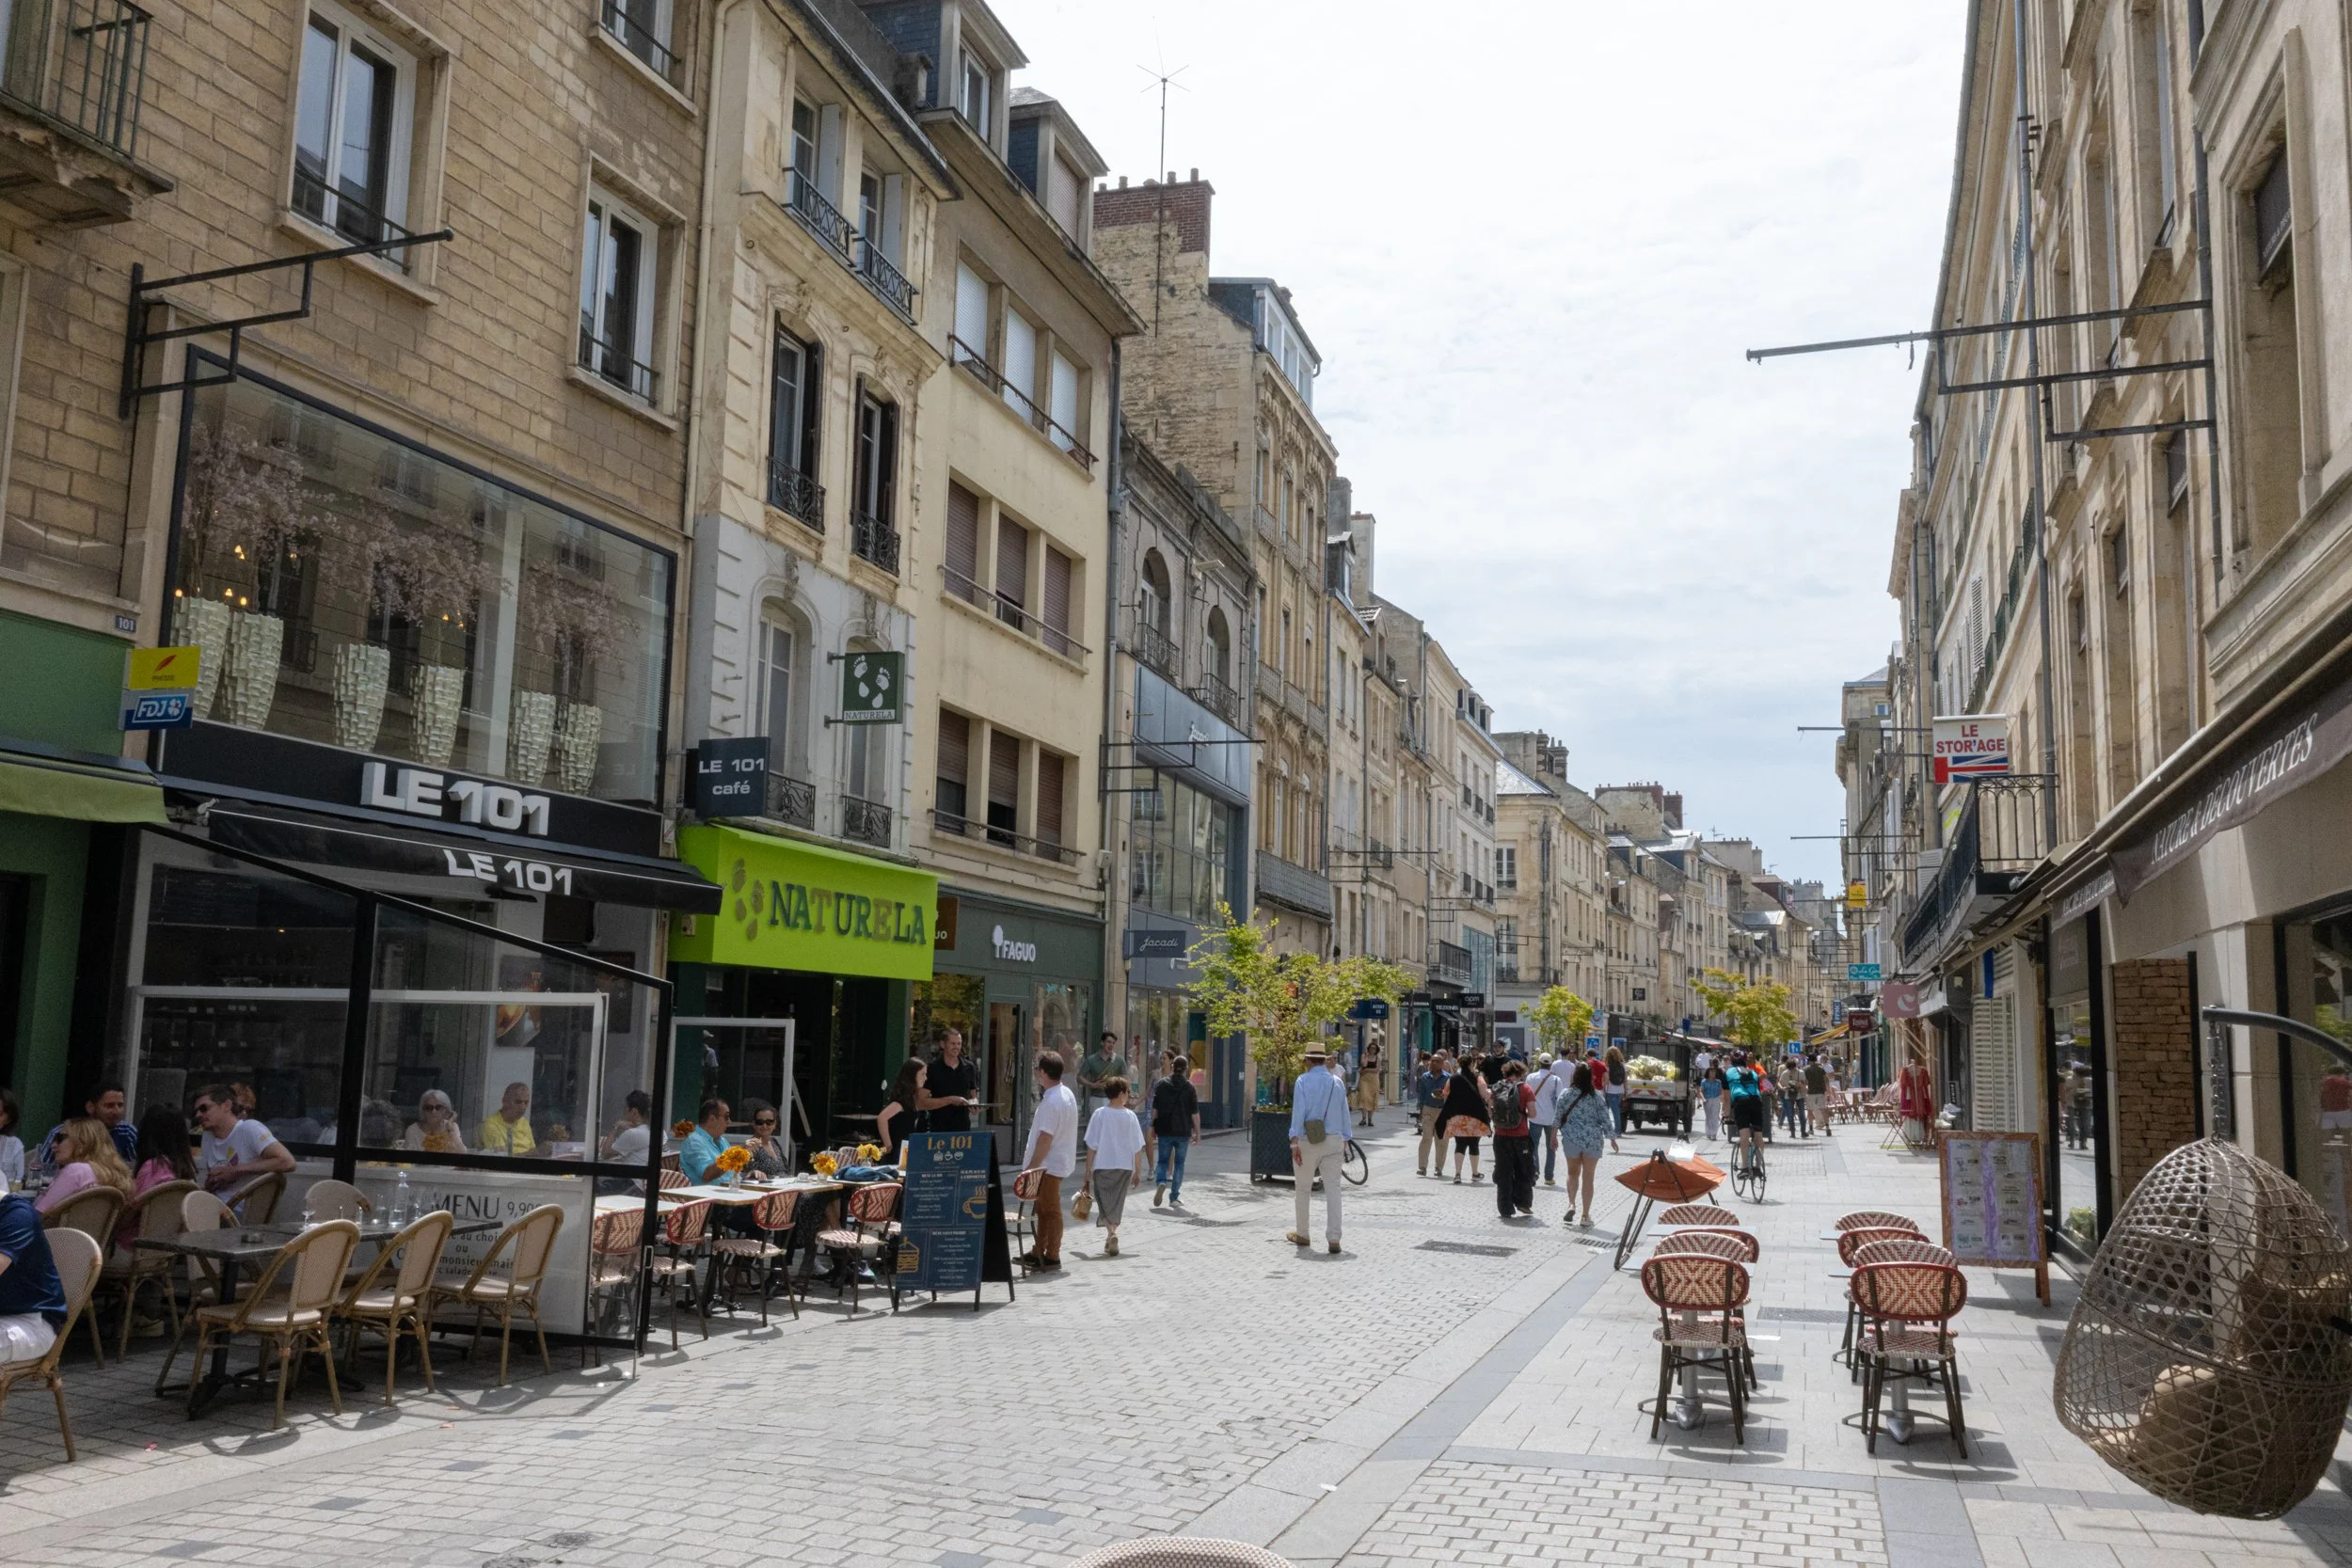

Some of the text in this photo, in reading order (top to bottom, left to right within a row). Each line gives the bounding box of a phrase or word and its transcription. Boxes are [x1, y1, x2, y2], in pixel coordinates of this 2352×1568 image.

[119, 617, 135, 631] 101
[136, 700, 168, 719] FDJ
[845, 711, 894, 721] NATURELA
[1961, 724, 1979, 738] LE
[1936, 738, 2006, 754] STOR'AGE
[698, 758, 765, 774] LE 101
[712, 780, 751, 796] café
[360, 762, 550, 836] LE 101
[2151, 806, 2195, 865] NATURE
[443, 849, 573, 896] LE 101
[769, 879, 928, 946] NATURELA
[1001, 942, 1036, 963] FAGUO
[927, 1134, 973, 1151] Le 101
[432, 1193, 501, 1220] MENU
[460, 1231, 472, 1242] au
[476, 1229, 500, 1243] choi
[455, 1244, 469, 1254] ou
[438, 1254, 482, 1267] monsieu
